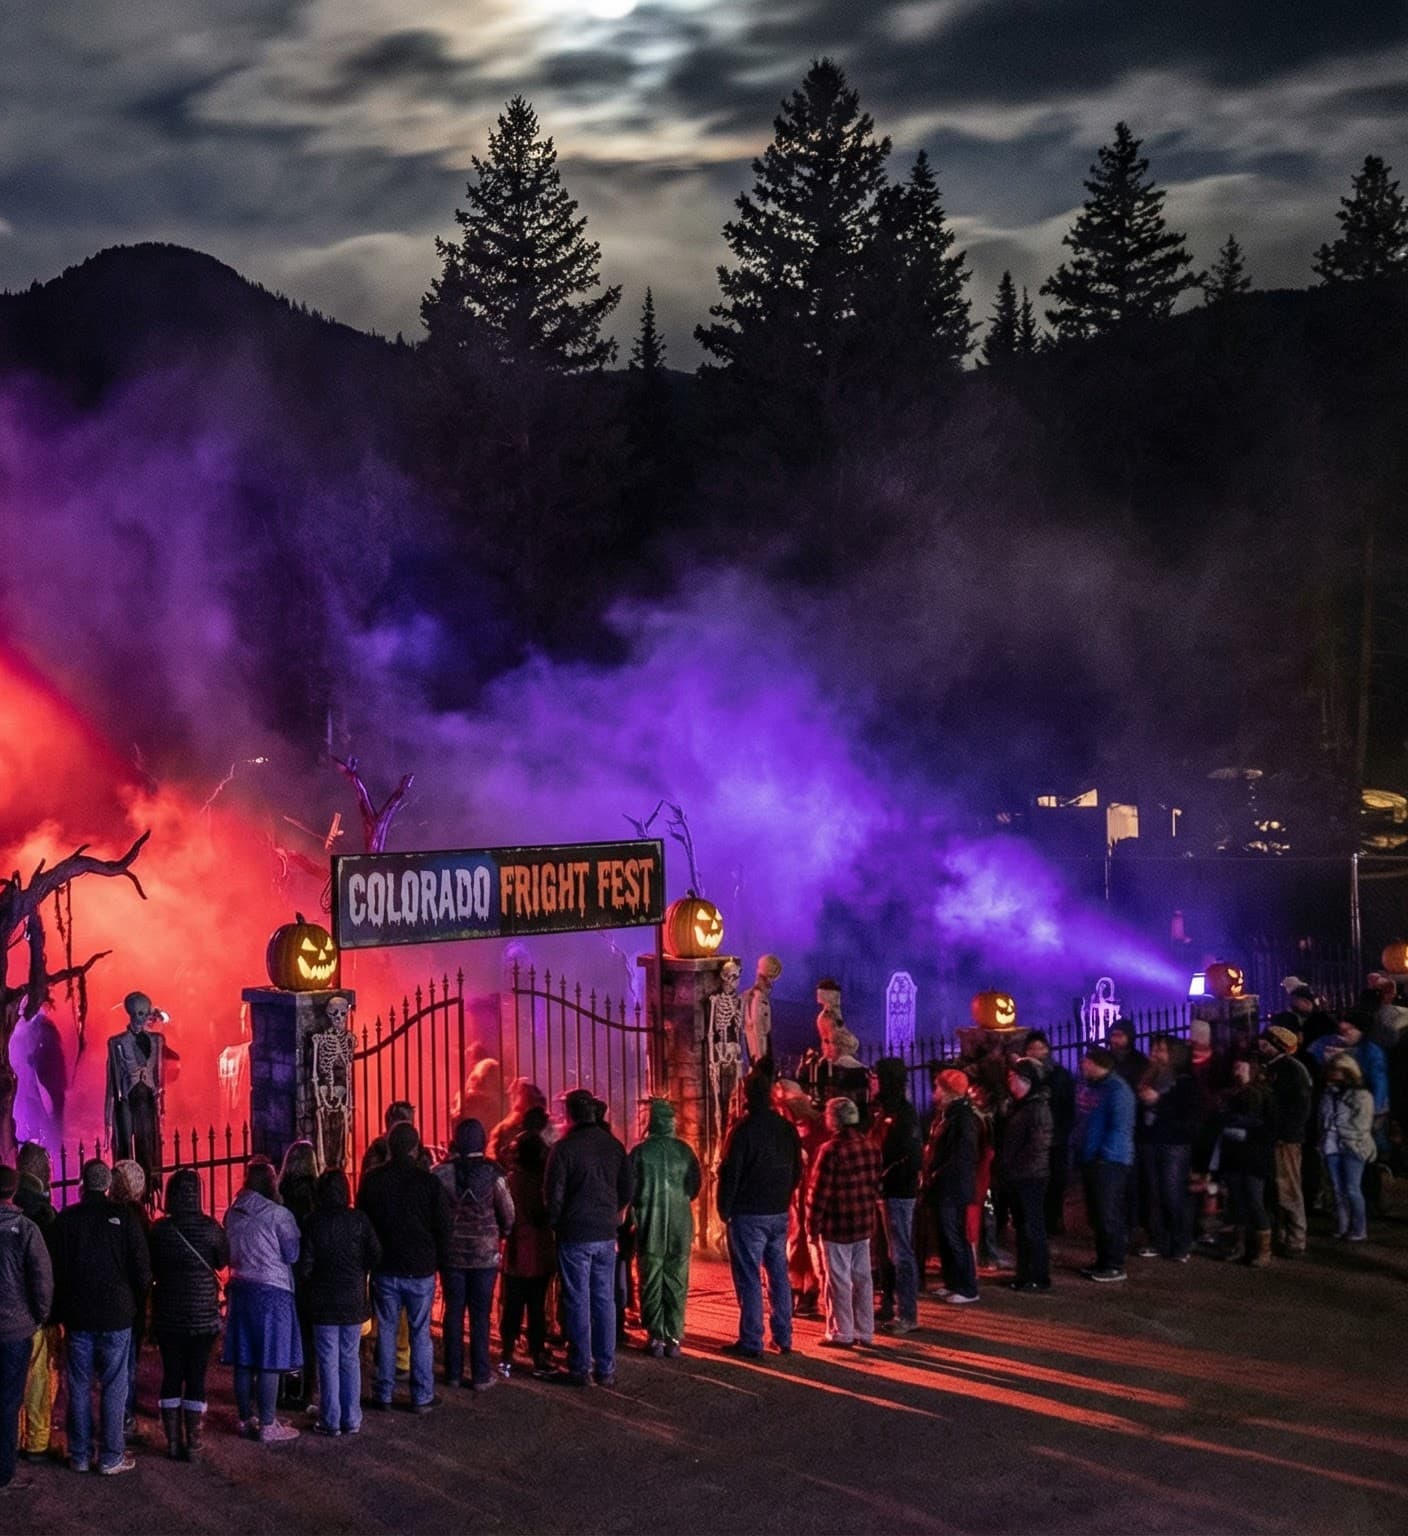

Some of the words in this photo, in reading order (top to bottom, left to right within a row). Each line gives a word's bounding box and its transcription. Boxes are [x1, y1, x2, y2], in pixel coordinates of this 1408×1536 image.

[349, 865, 491, 928] COLORADO
[500, 862, 590, 919] FRIGHT
[597, 858, 655, 914] FEST
